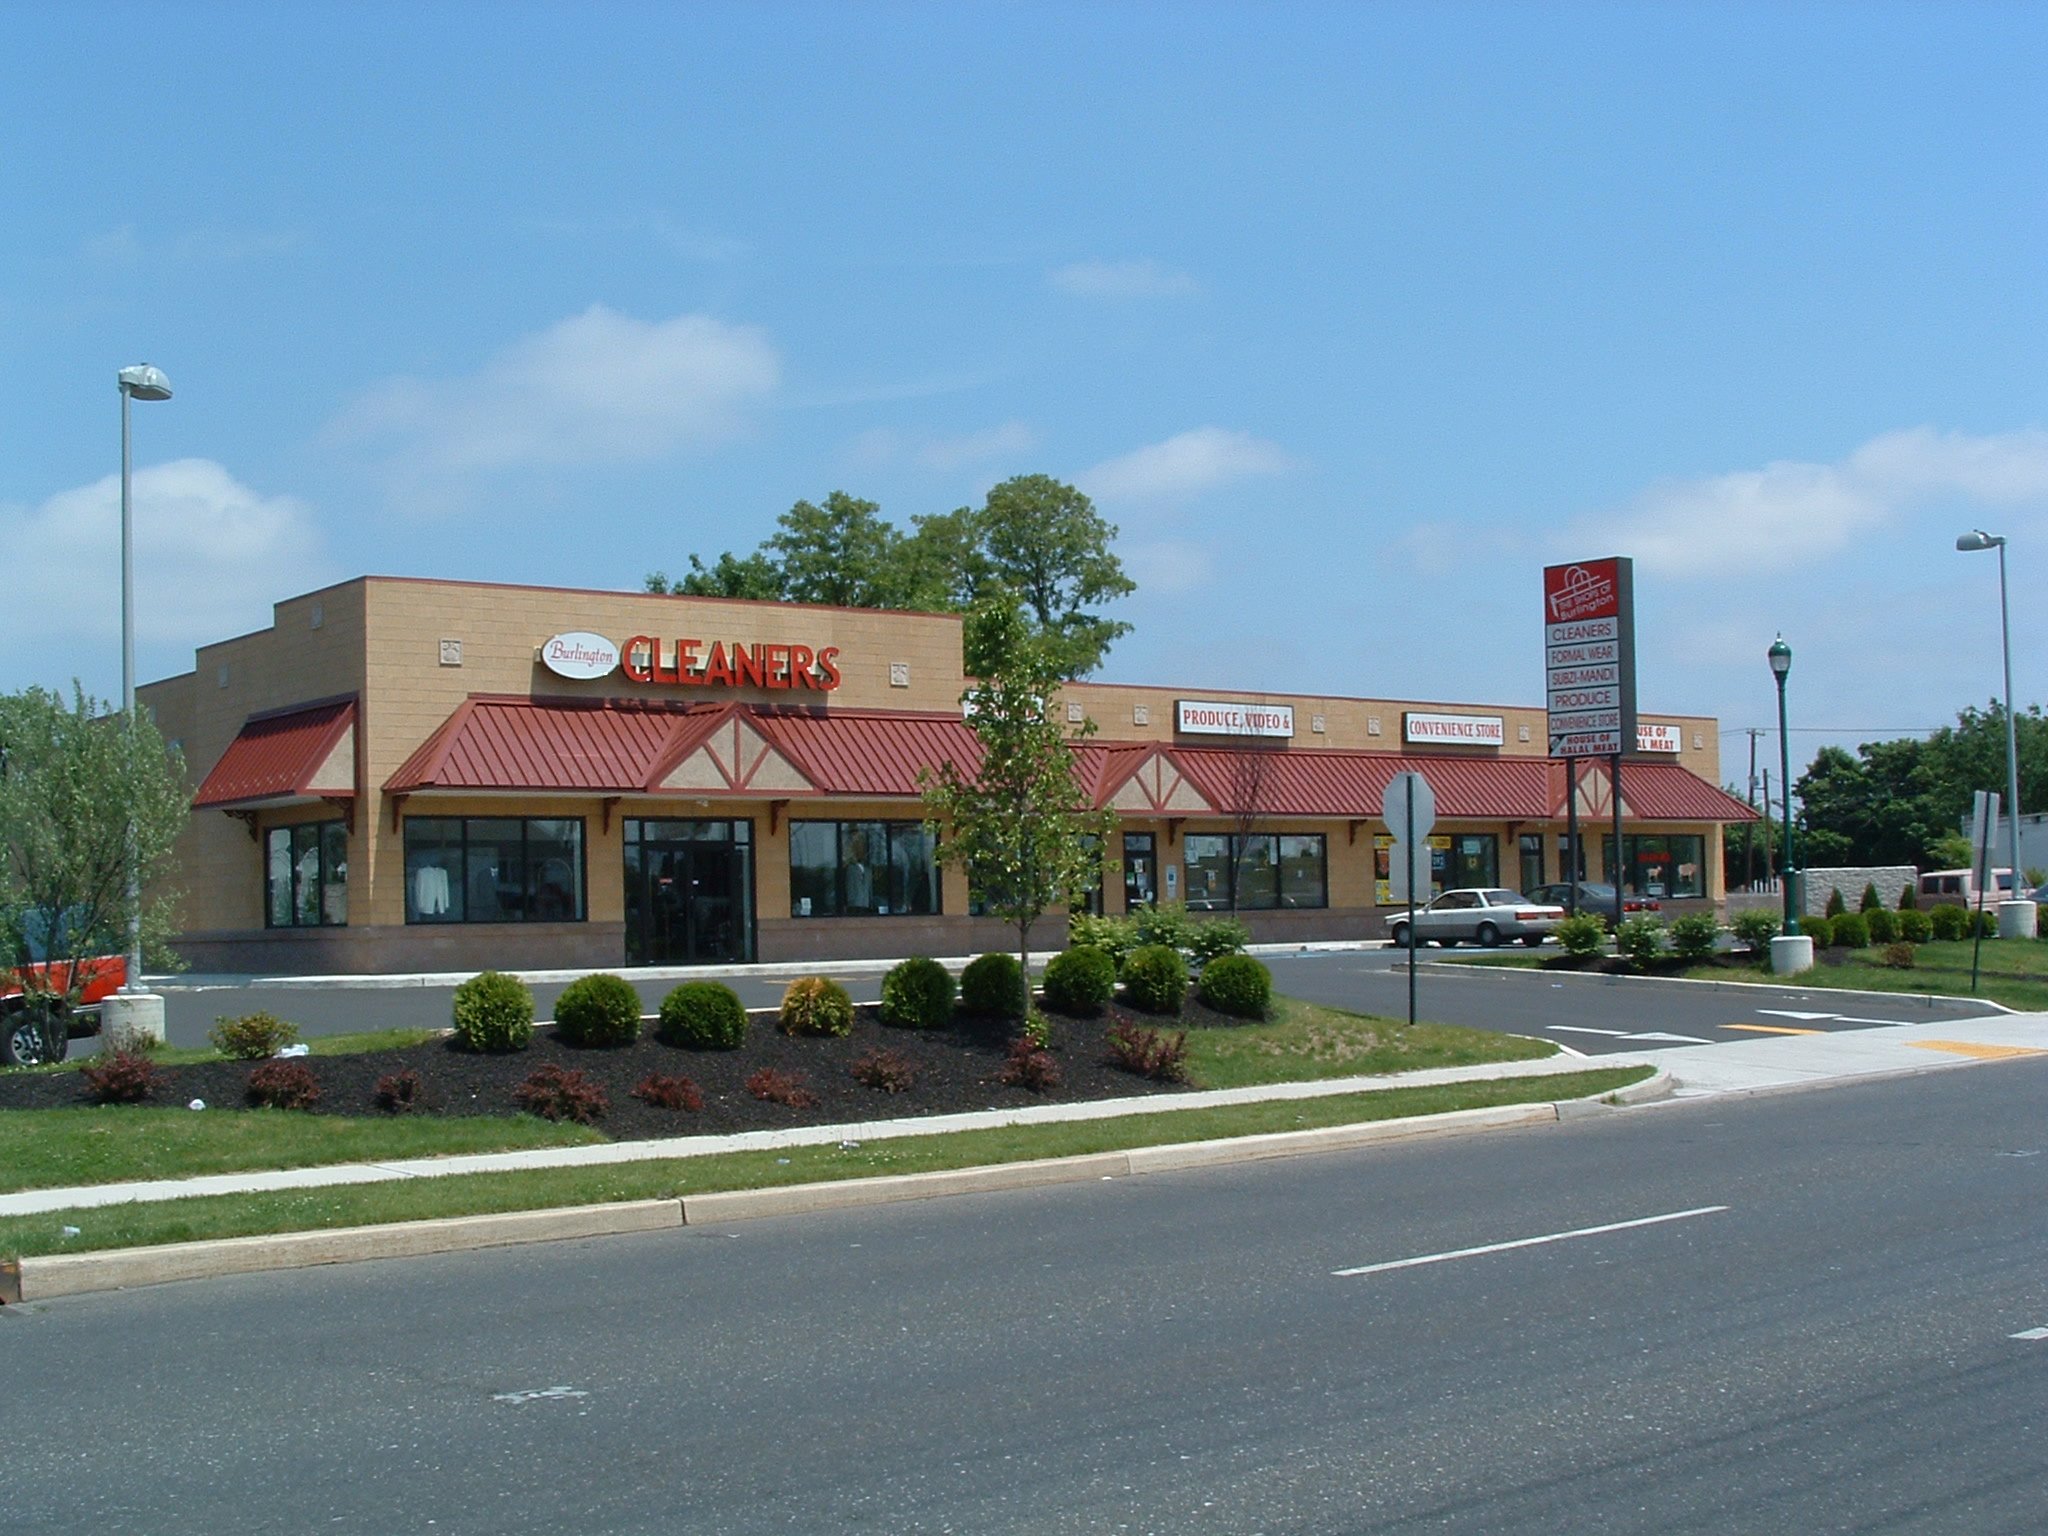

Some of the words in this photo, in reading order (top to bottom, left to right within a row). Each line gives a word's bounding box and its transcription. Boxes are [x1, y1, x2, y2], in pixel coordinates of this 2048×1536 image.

[1560, 594, 1614, 620] Burlington
[1553, 623, 1612, 641] CLEANERS
[550, 640, 613, 668] Burlington
[1552, 648, 1586, 664] FORMAL
[1588, 645, 1614, 659] WEAR
[621, 635, 841, 691] CLEANERS
[1555, 691, 1611, 707] PRODUCE
[1245, 713, 1280, 729] VIDEO
[1282, 715, 1290, 729] &
[1599, 712, 1618, 726] STORE
[1409, 720, 1474, 737] CONVENIENCE
[1476, 724, 1501, 737] STORE
[1637, 726, 1653, 737] USE
[1656, 727, 1668, 738] OF
[1567, 735, 1596, 745] HOUSE
[1600, 734, 1611, 743] OF
[1650, 739, 1674, 750] MEAT
[1560, 745, 1589, 755] HALAL
[1593, 743, 1618, 752] MEAT
